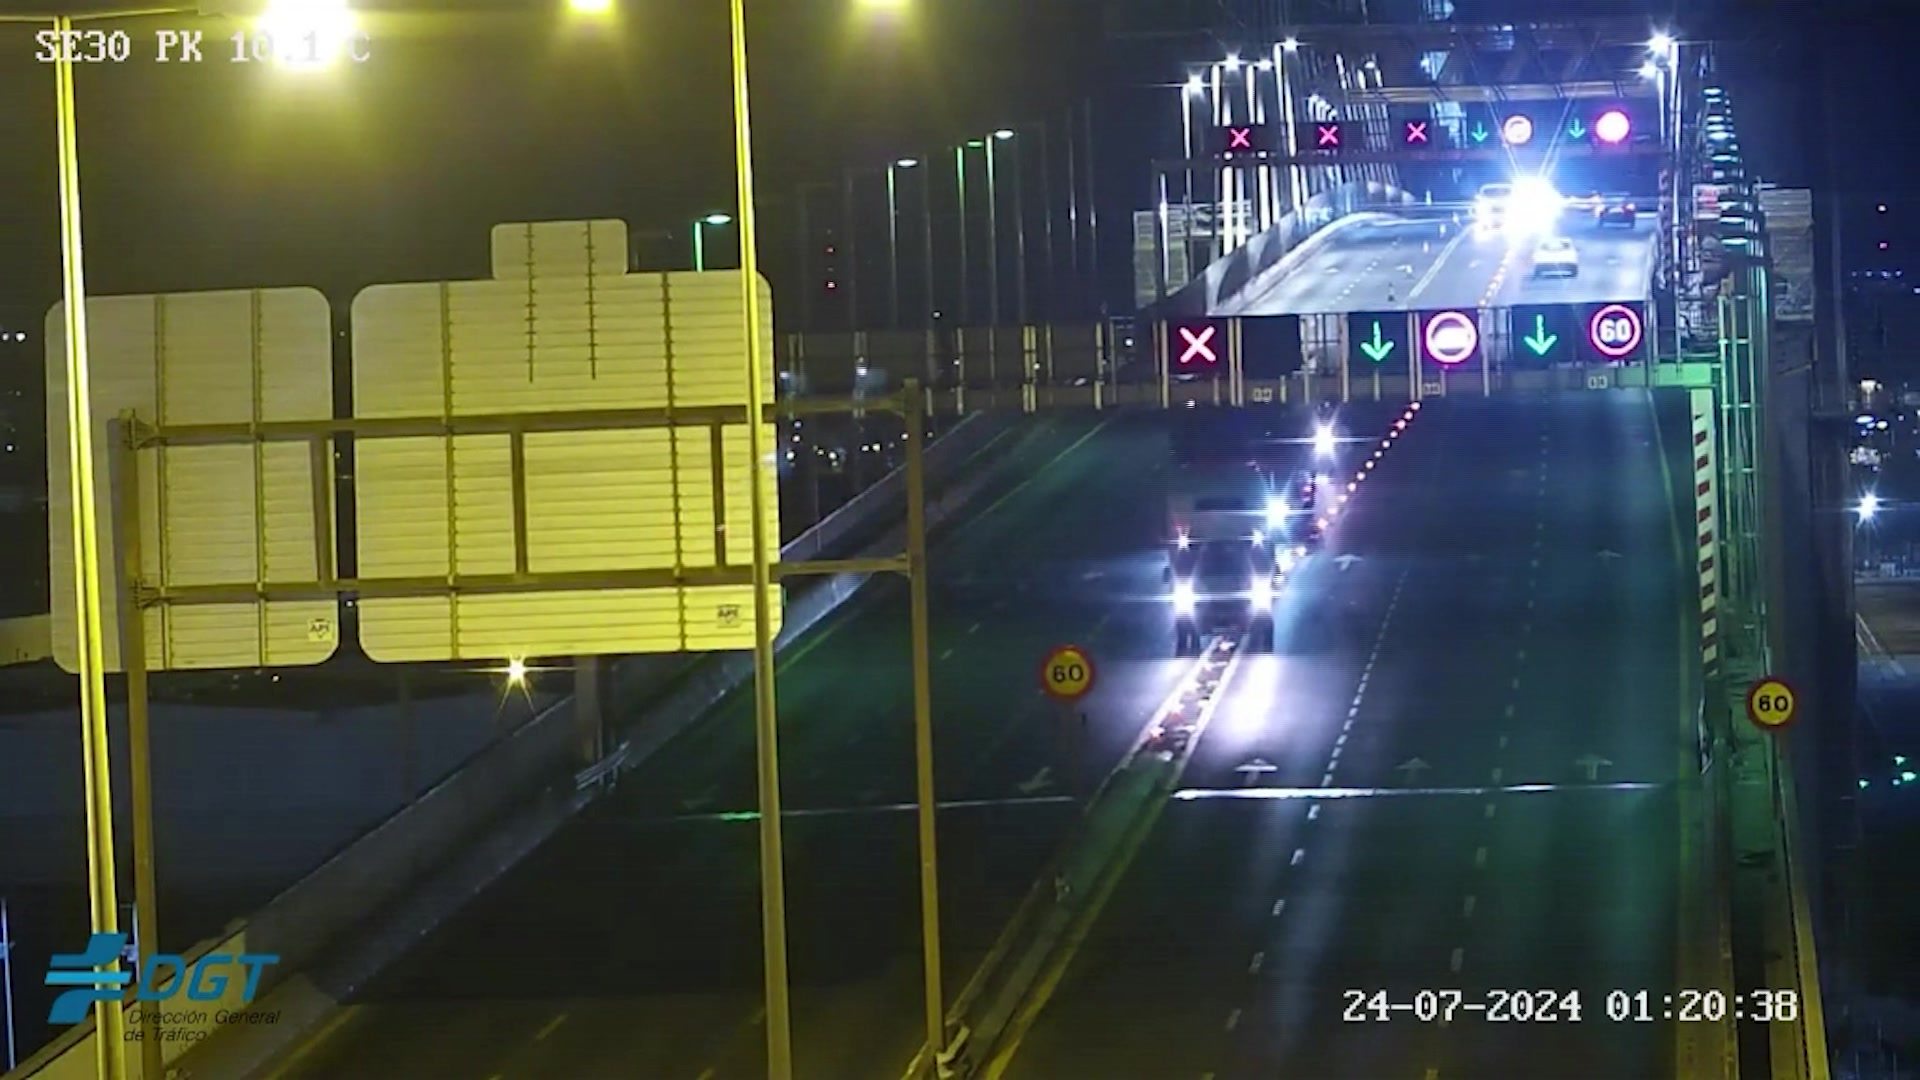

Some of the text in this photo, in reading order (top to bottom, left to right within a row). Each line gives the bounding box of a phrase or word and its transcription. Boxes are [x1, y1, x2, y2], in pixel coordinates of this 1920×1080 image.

[1600, 318, 1631, 342] 60
[1053, 664, 1084, 683] 60
[1759, 695, 1788, 712] 60
